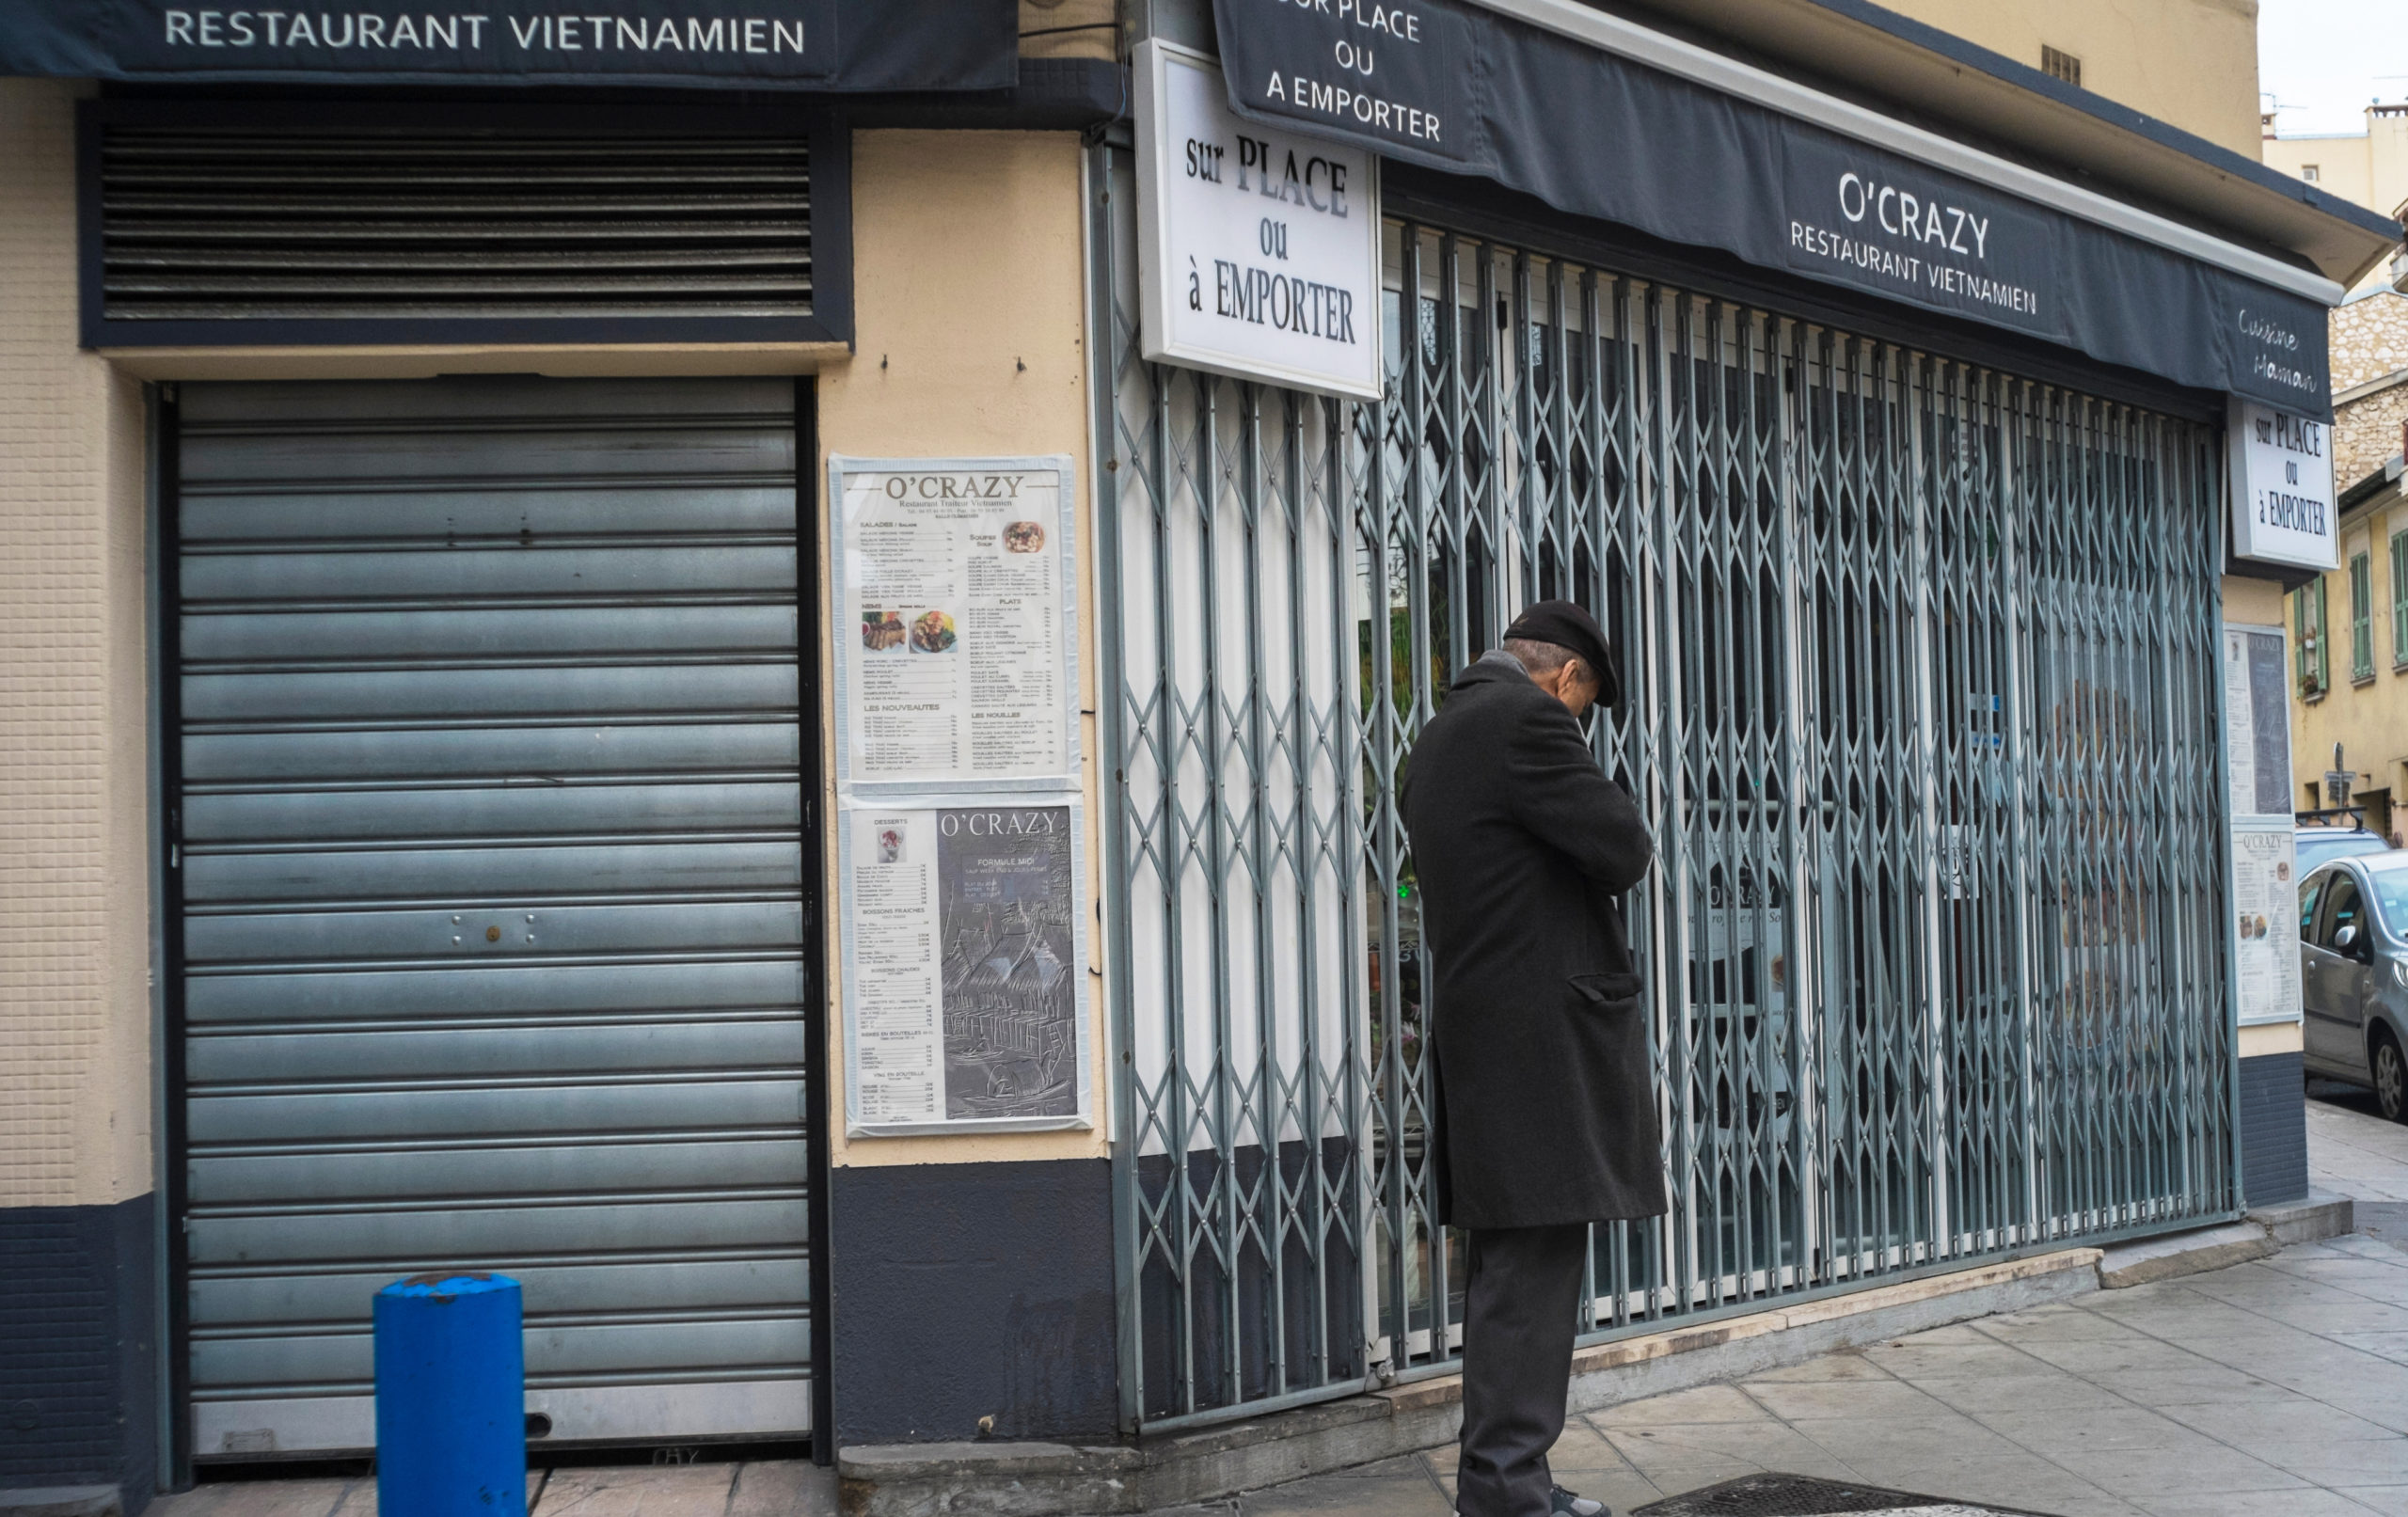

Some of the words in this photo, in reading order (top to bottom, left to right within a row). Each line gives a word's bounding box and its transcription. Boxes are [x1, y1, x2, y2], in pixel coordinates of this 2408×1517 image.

[166, 10, 489, 49] RESTAURANT
[509, 16, 803, 54] VIETNAMIEN
[1339, 0, 1419, 42] PLACE
[1336, 40, 1373, 75] OU
[1267, 71, 1285, 101] A
[1294, 77, 1440, 142] EMPORTER
[1187, 138, 1224, 183] sur
[1237, 134, 1348, 218] PLACE
[1839, 173, 1988, 259] O'CRAZY
[1260, 217, 1288, 260] ou
[1791, 221, 1920, 282] RESTAURANT
[1927, 263, 2036, 314] VIETNAMIEN
[1190, 254, 1202, 311] à
[1214, 260, 1355, 344] EMPORTER
[2240, 309, 2299, 350] Cuisine
[2255, 354, 2317, 392] Maman
[2256, 419, 2272, 445] sur
[2276, 412, 2321, 457] PLACE
[886, 476, 1023, 499] O'CRAZY
[2286, 460, 2298, 485] ou
[899, 499, 938, 508] Restaurant
[941, 499, 968, 508] Traiteur
[971, 498, 1012, 507] Vietnamien
[2259, 489, 2265, 523] à
[2269, 491, 2326, 536] EMPORTER
[942, 812, 1058, 836] O'CRAZY
